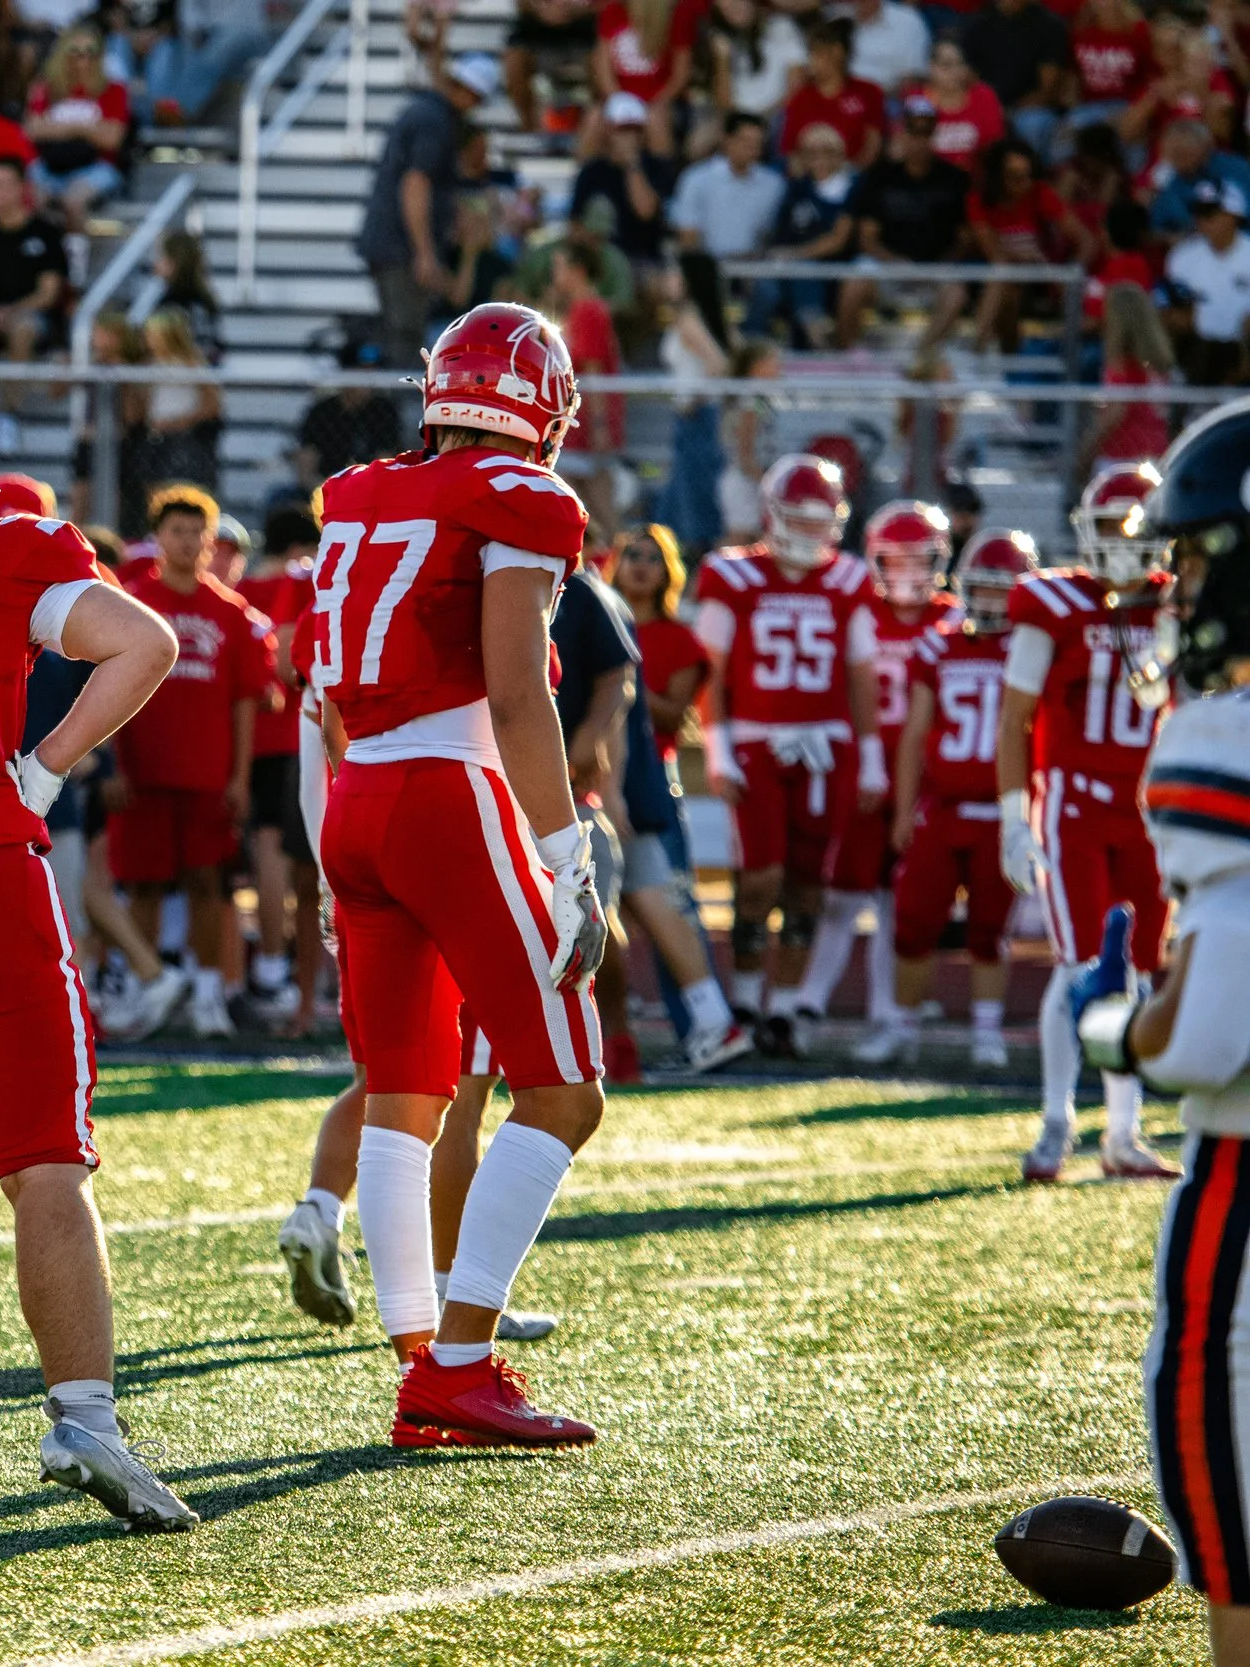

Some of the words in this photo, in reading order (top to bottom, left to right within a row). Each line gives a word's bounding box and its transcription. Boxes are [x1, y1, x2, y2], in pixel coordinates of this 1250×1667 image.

[310, 518, 437, 688] 97
[752, 611, 836, 692] 55
[939, 676, 1000, 763] 51
